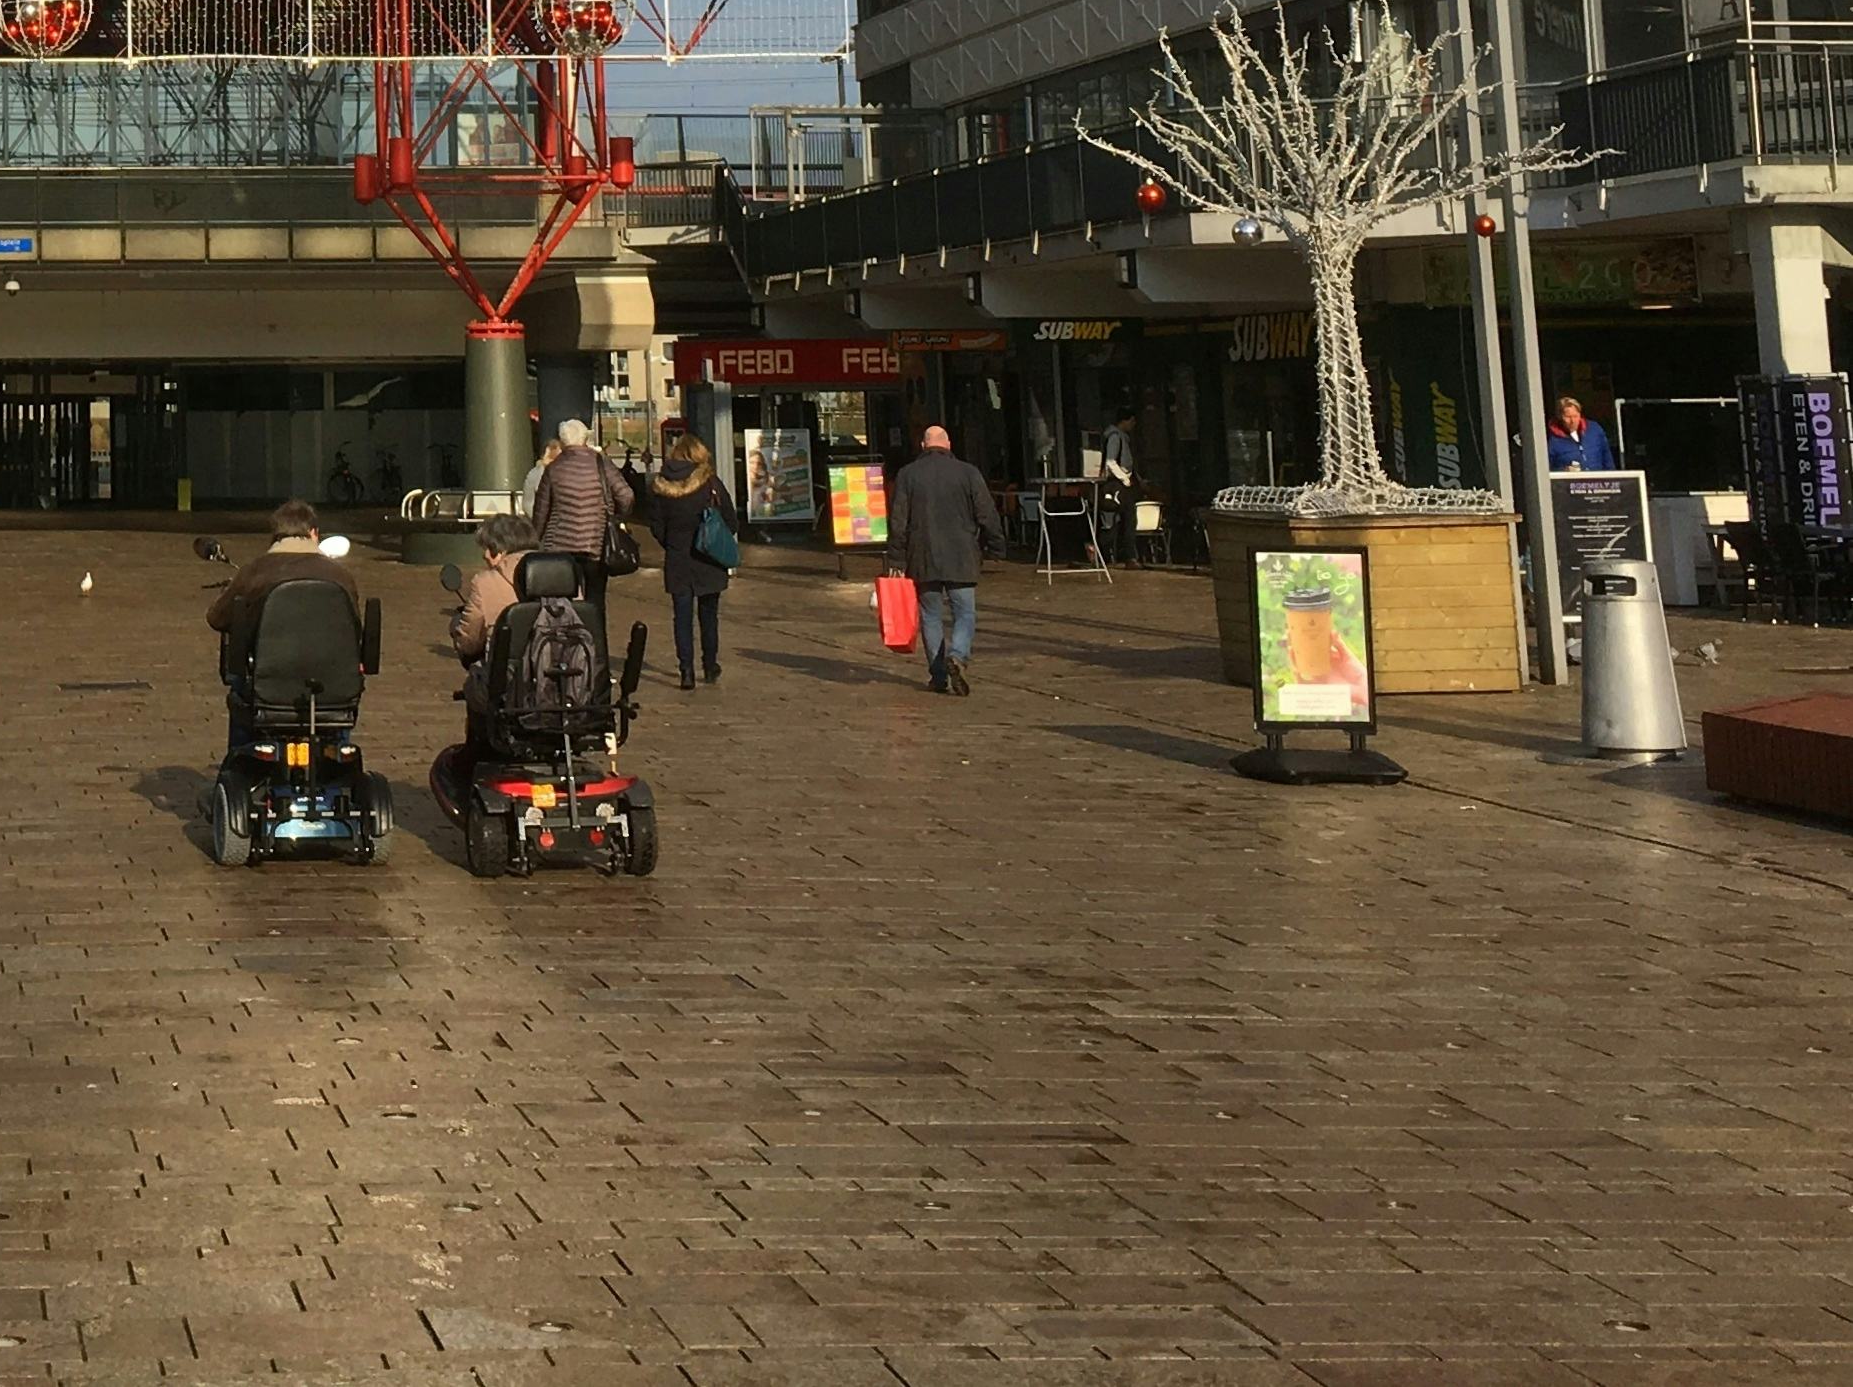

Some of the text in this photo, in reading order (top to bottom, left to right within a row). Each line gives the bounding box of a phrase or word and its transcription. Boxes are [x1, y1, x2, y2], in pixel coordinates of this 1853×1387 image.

[1033, 321, 1122, 341] SUBWAY
[1228, 310, 1315, 362] SUBWAY
[718, 349, 794, 375] FEBO
[842, 348, 901, 374] FEB
[1429, 381, 1462, 489] SUBWAY
[1792, 393, 1810, 452] ETEN
[1798, 459, 1812, 475] &
